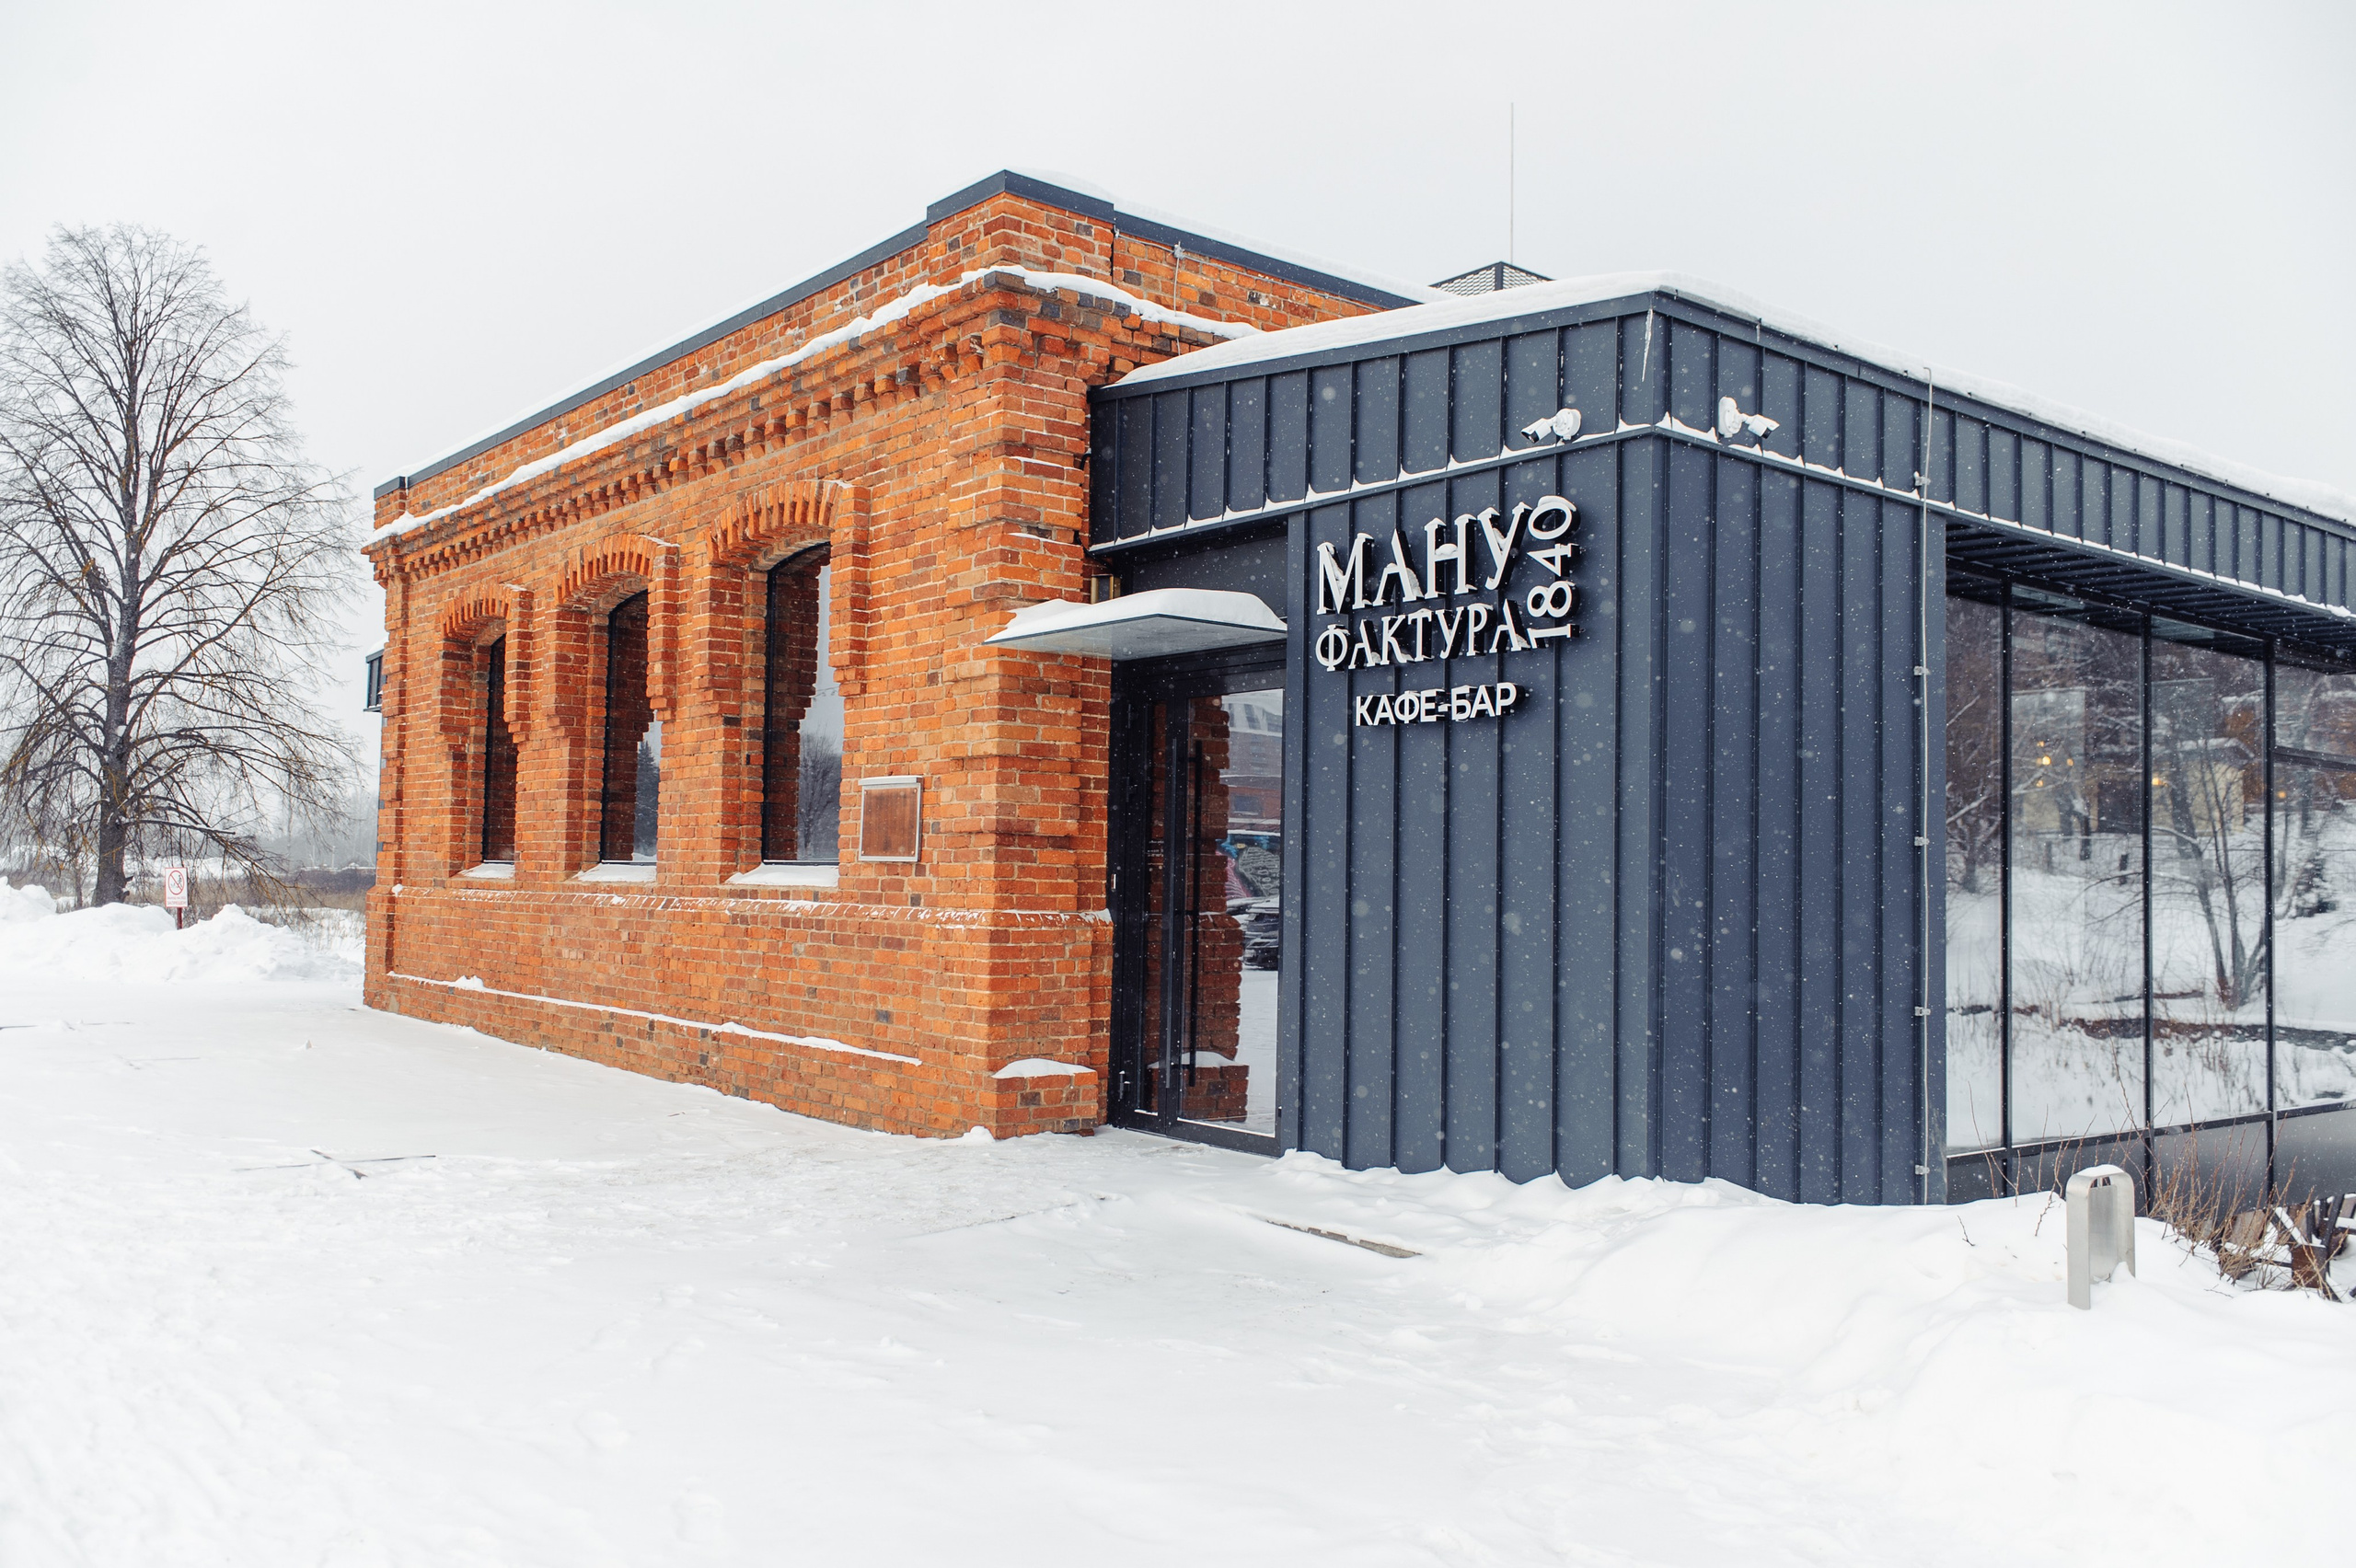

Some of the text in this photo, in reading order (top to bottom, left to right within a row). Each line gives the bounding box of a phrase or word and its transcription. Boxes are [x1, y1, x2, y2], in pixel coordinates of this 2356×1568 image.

[1317, 502, 1532, 615] МАНУ
[1527, 496, 1576, 650] 1840
[1315, 598, 1529, 672] ФАКТУРА
[1356, 682, 1517, 726] КАФЕ-БАР
